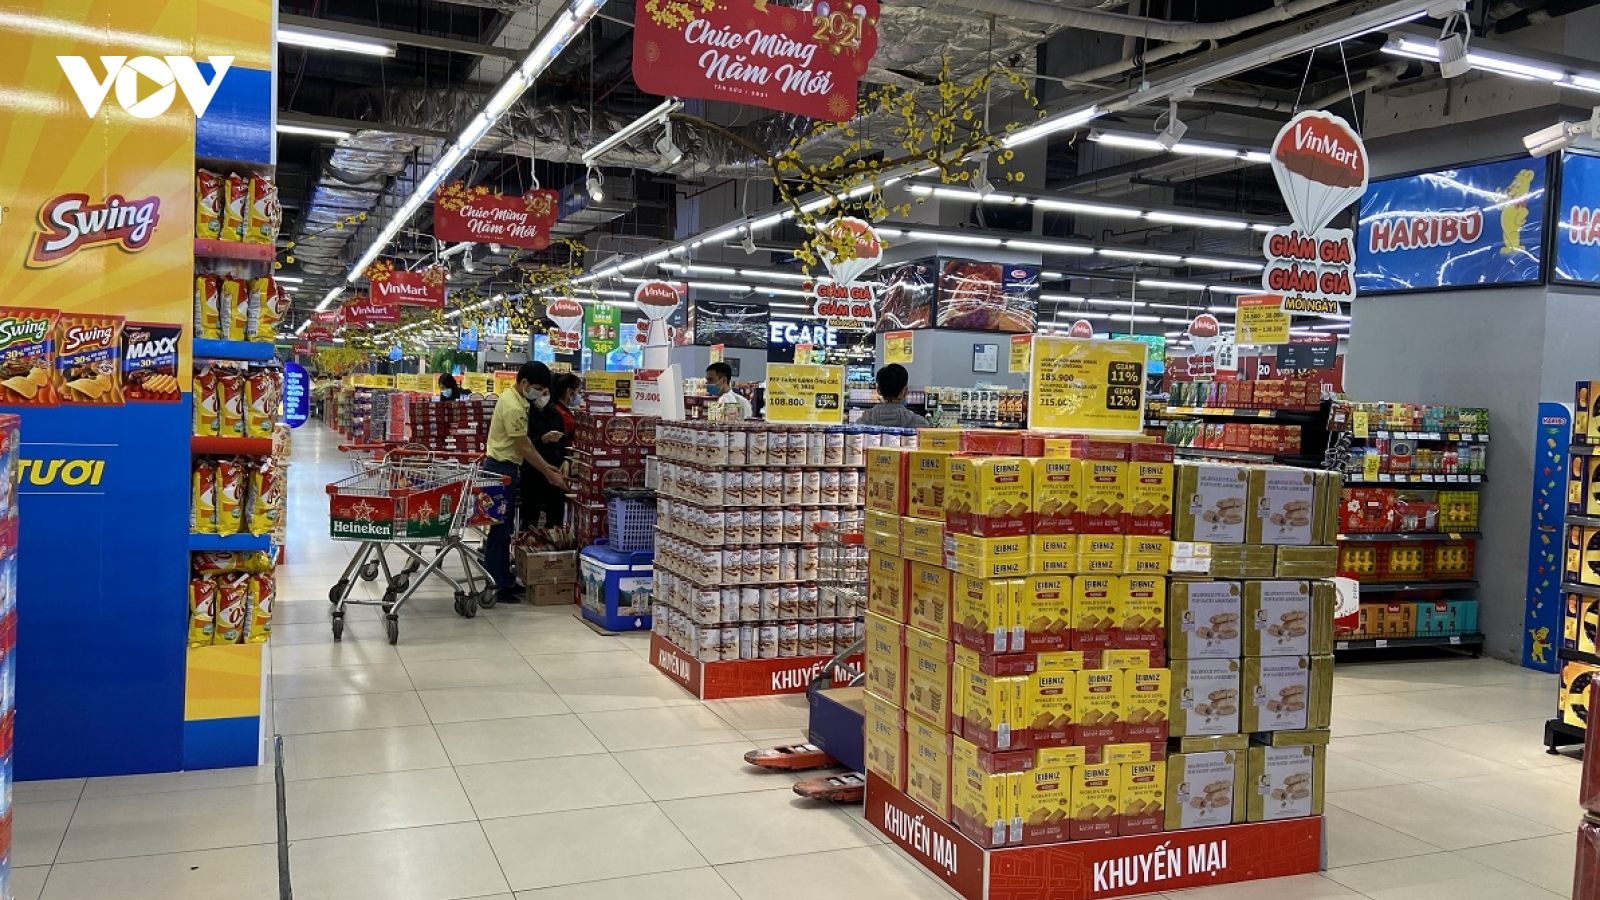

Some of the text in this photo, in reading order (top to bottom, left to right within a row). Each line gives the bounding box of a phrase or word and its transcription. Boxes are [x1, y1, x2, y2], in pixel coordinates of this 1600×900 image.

[684, 18, 743, 49] Chúc
[812, 11, 864, 47] 2021
[698, 49, 835, 96] Năm Mới
[1294, 123, 1358, 169] VinMart
[460, 205, 489, 218] Chúc
[46, 200, 154, 251] Swing
[467, 218, 538, 239] Năm Mới
[1370, 208, 1484, 253] HARIBO
[1269, 231, 1351, 264] GIẢM GIÁ
[1269, 263, 1351, 295] GIẢM GIÁ
[378, 282, 428, 296] VinMart
[644, 286, 674, 299] VinMart
[850, 286, 872, 301] GIÁ
[351, 306, 388, 316] VinMart
[554, 303, 579, 311] VinMart
[852, 302, 872, 318] GIÁ
[0, 318, 46, 343] Swing
[67, 326, 112, 349] Swing
[126, 337, 177, 359] MAXX
[1041, 373, 1074, 382] 185.900
[1111, 371, 1138, 381] 11%
[769, 398, 804, 406] 108.800
[1110, 396, 1136, 407] 12%
[994, 464, 1019, 475] LEIBNIZ
[1045, 462, 1071, 474] LEIBNIZ
[1094, 463, 1117, 474] LEIBNIZ
[1140, 465, 1163, 476] LEIBNIZ
[333, 521, 391, 535] Heineken
[994, 544, 1018, 554] LEIBNIZ
[1043, 541, 1067, 550] LEIBNIZ
[1091, 541, 1114, 550] LEIBNIZ
[1139, 542, 1162, 551] LEIBNIZ
[994, 564, 1018, 574] LEIBNIZ
[1043, 561, 1067, 570] LEIBNIZ
[1089, 561, 1113, 570] LEIBNIZ
[1137, 561, 1159, 570] LEIBNIZ
[1035, 581, 1060, 592] LEIBNIZ
[1085, 580, 1108, 590] LEIBNIZ
[1130, 580, 1154, 590] LEIBNIZ
[1039, 677, 1064, 687] LEIBNIZ
[1088, 674, 1113, 685] LEIBNIZ
[1136, 673, 1160, 683] LEIBNIZ
[1085, 769, 1109, 780] LEIBNIZ
[1132, 764, 1156, 776] LEIBNIZ
[1035, 772, 1060, 783] LEIBNIZ
[885, 801, 957, 876] KHUYẾN MẠI
[1093, 839, 1227, 892] KHUYẾN MẠI
